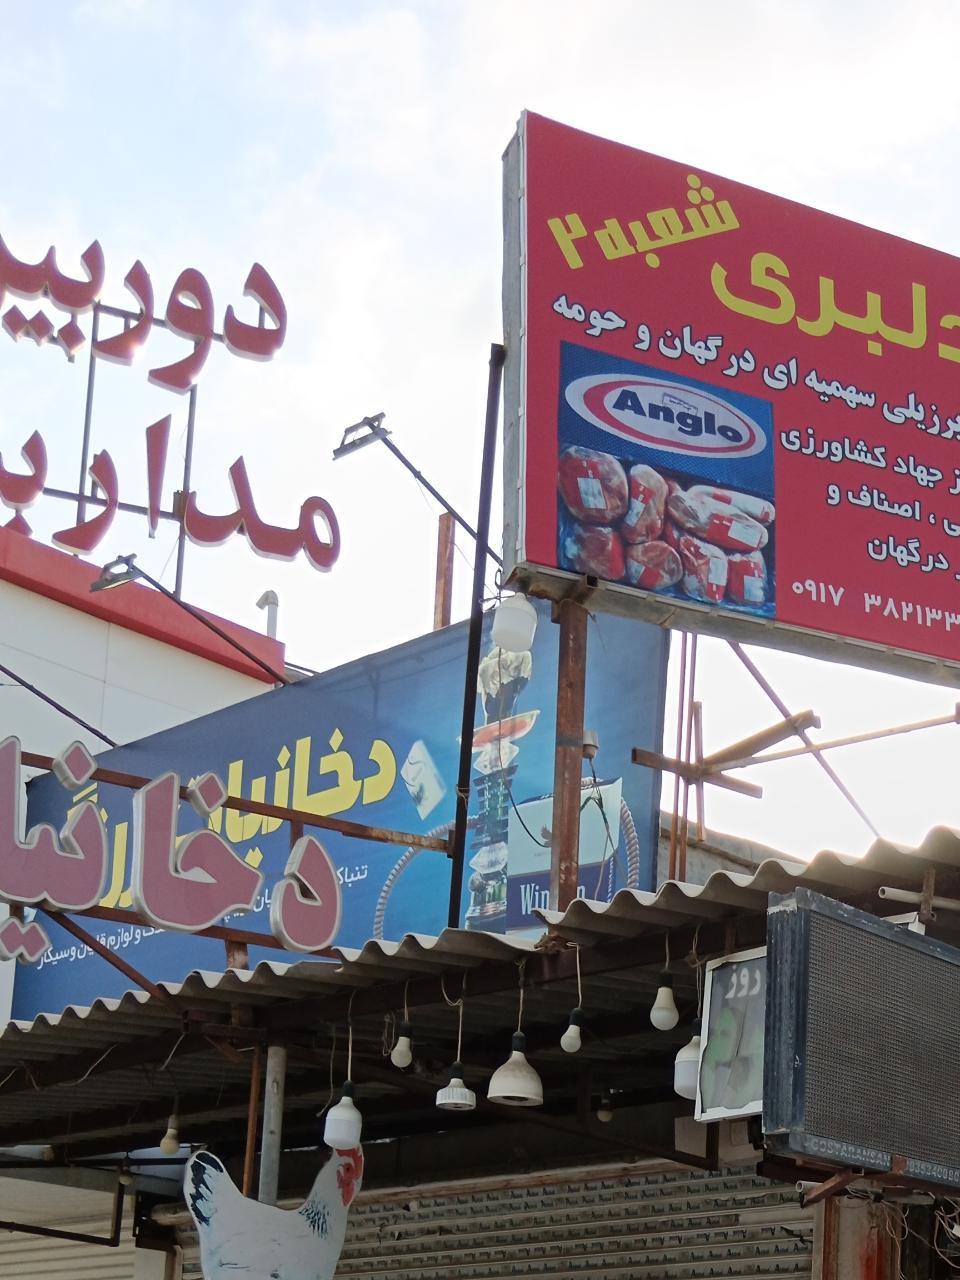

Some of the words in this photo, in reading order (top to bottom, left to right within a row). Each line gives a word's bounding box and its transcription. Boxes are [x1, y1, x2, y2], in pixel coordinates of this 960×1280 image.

[547, 213, 588, 269] ۲
[594, 174, 740, 269] شعبه
[0, 233, 288, 395] دوربی
[552, 294, 627, 338] حومه
[634, 323, 652, 352] و
[804, 369, 876, 409] سهمیه
[611, 388, 744, 443] Anglo
[780, 427, 888, 470] کشاورزی
[892, 455, 944, 488] جهاد
[0, 414, 342, 573] مدارب
[827, 483, 841, 506] و
[847, 483, 921, 521] اصناف
[792, 578, 846, 607] ۰۹۱۷
[0, 735, 343, 965] دخانیا
